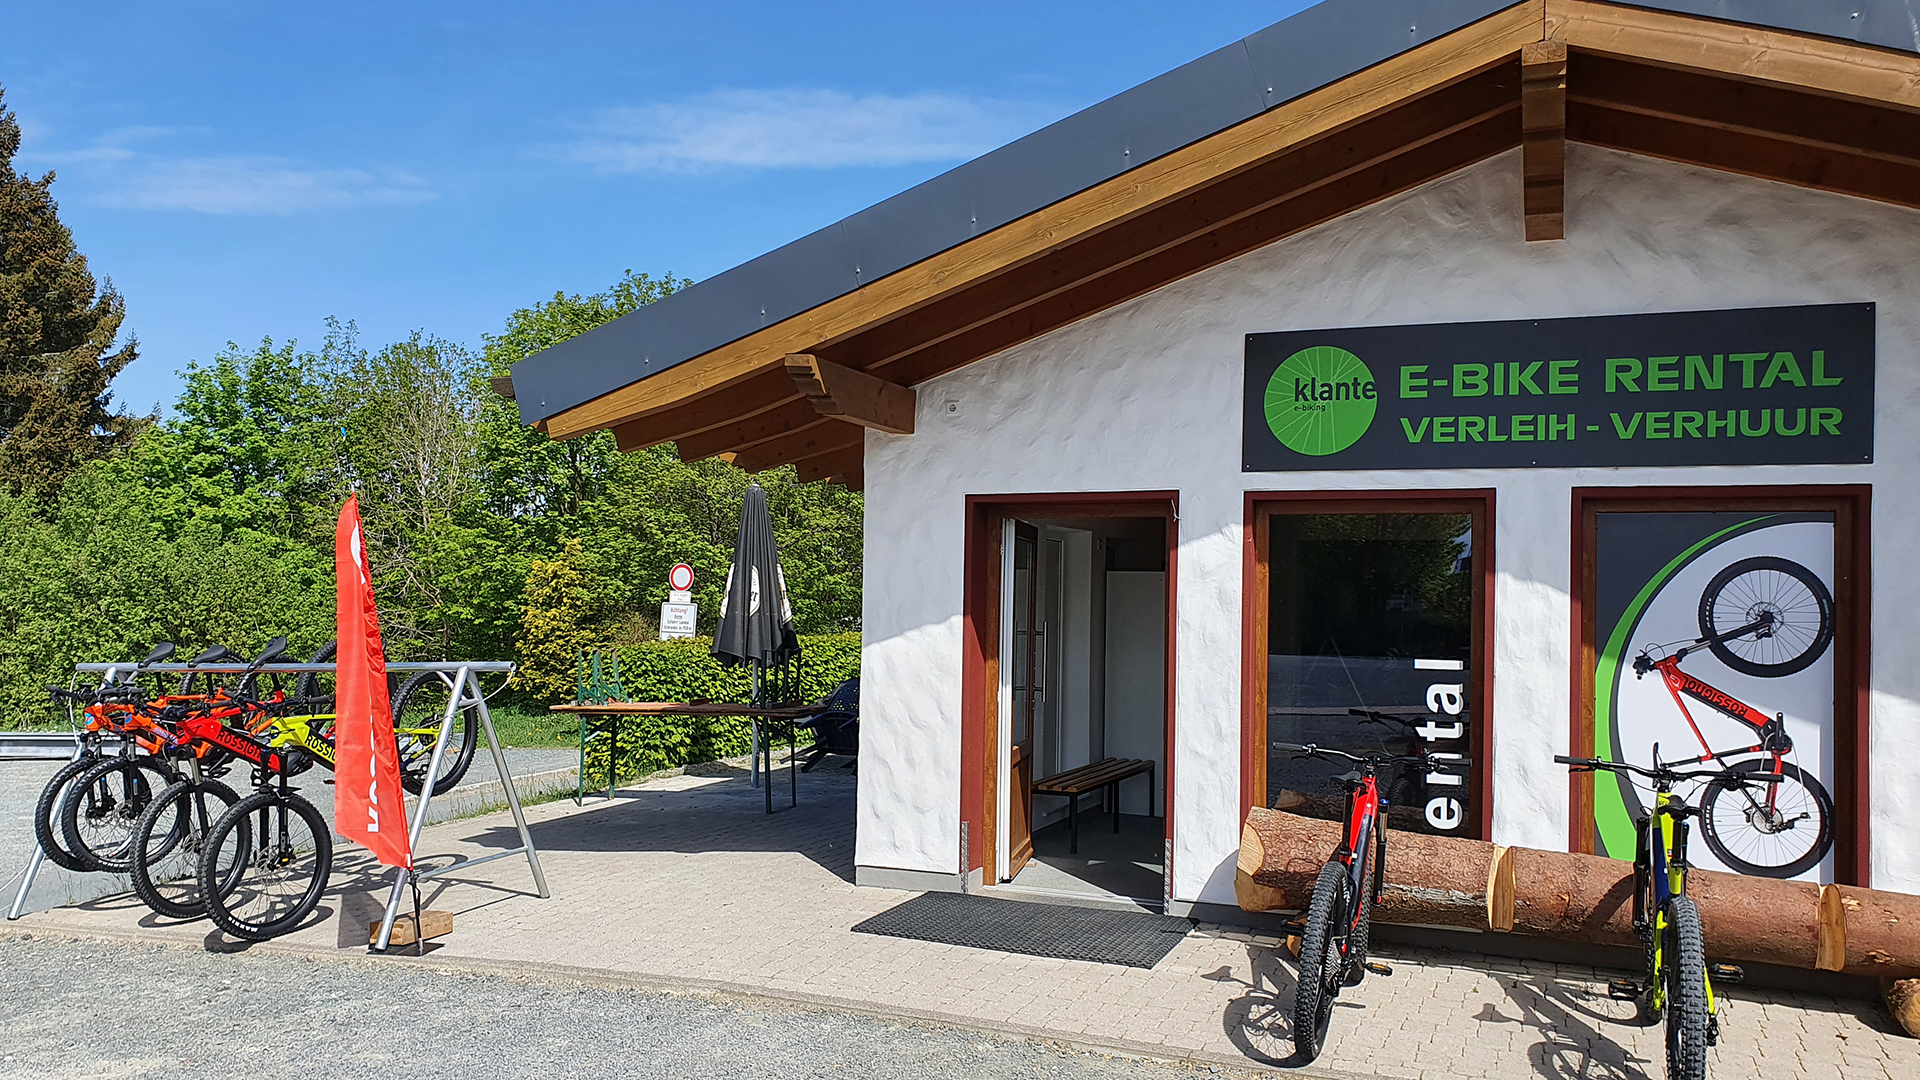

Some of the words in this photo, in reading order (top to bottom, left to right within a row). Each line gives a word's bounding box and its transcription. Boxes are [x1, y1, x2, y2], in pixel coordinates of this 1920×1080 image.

[1294, 377, 1378, 402] klante
[1399, 359, 1580, 399] E-BIKE
[1604, 350, 1844, 393] RENTAL
[1293, 404, 1326, 412] e-biking
[1399, 413, 1576, 443] VERLEIH
[1609, 407, 1844, 440] VERHUUR
[1682, 675, 1748, 717] ROSSIGNOL
[216, 730, 273, 764] ROSSIGN
